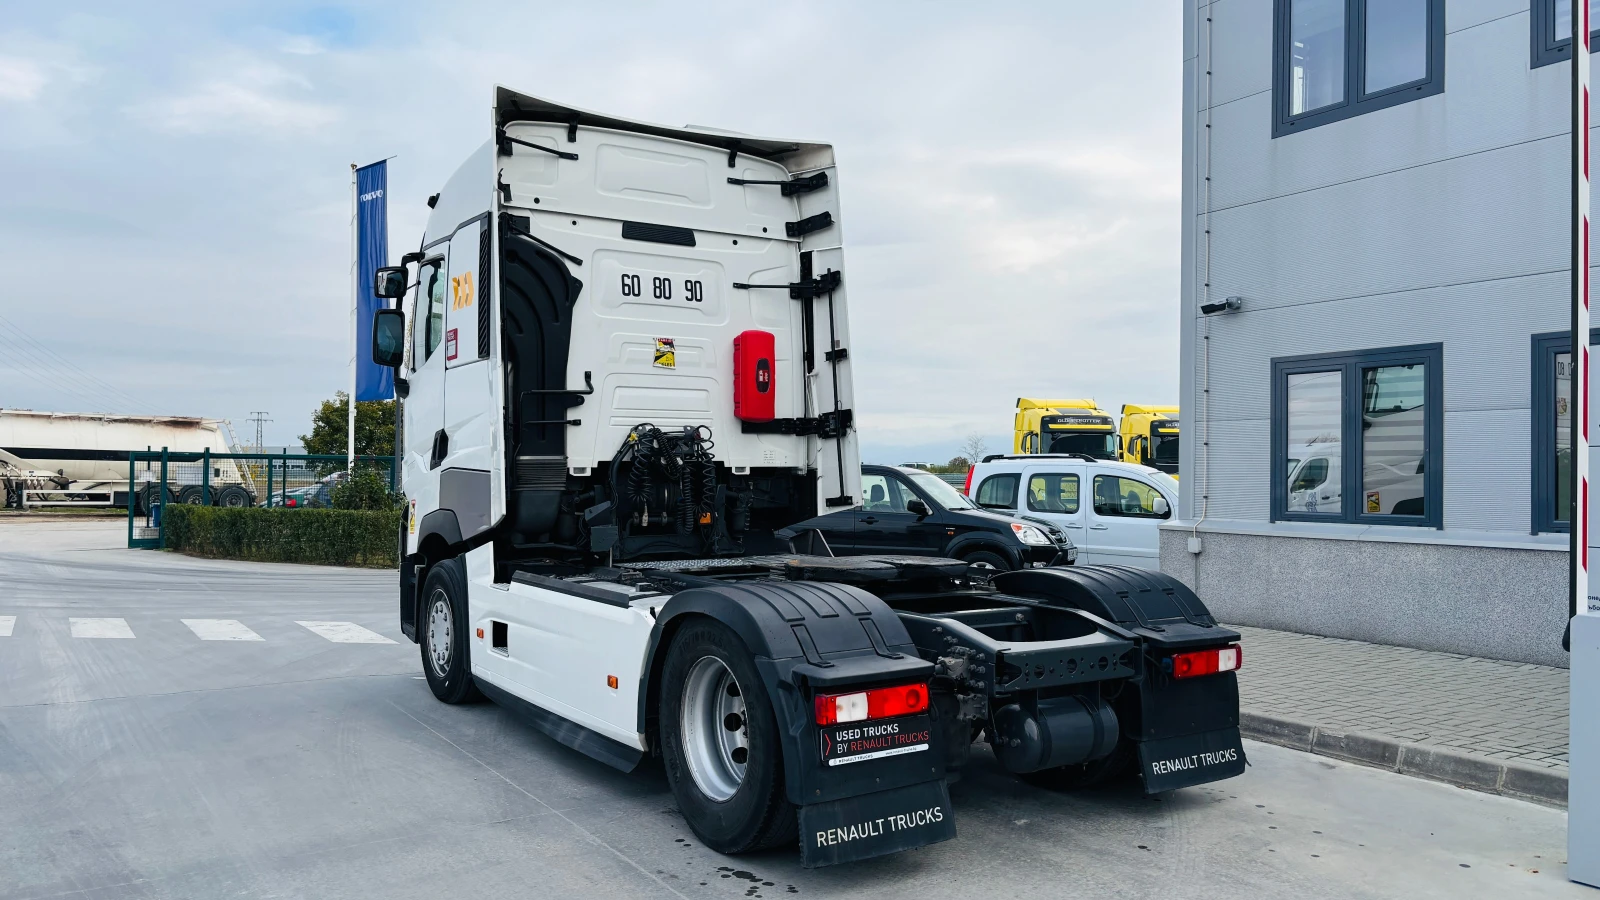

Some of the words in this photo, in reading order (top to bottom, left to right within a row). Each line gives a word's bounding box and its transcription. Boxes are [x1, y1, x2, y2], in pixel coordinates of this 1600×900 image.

[621, 273, 641, 297] 60
[653, 276, 672, 300] 80
[684, 279, 703, 302] 90
[836, 729, 861, 742] USED
[862, 723, 899, 738] TRUCKS
[837, 742, 848, 754] BY
[850, 735, 892, 752] RENAULT
[893, 731, 930, 745] TRUCKS
[1152, 755, 1198, 775] RENAULT
[1199, 748, 1238, 767] TRUCKS
[816, 818, 885, 848] RENAULT
[887, 806, 943, 832] TRUCKS
